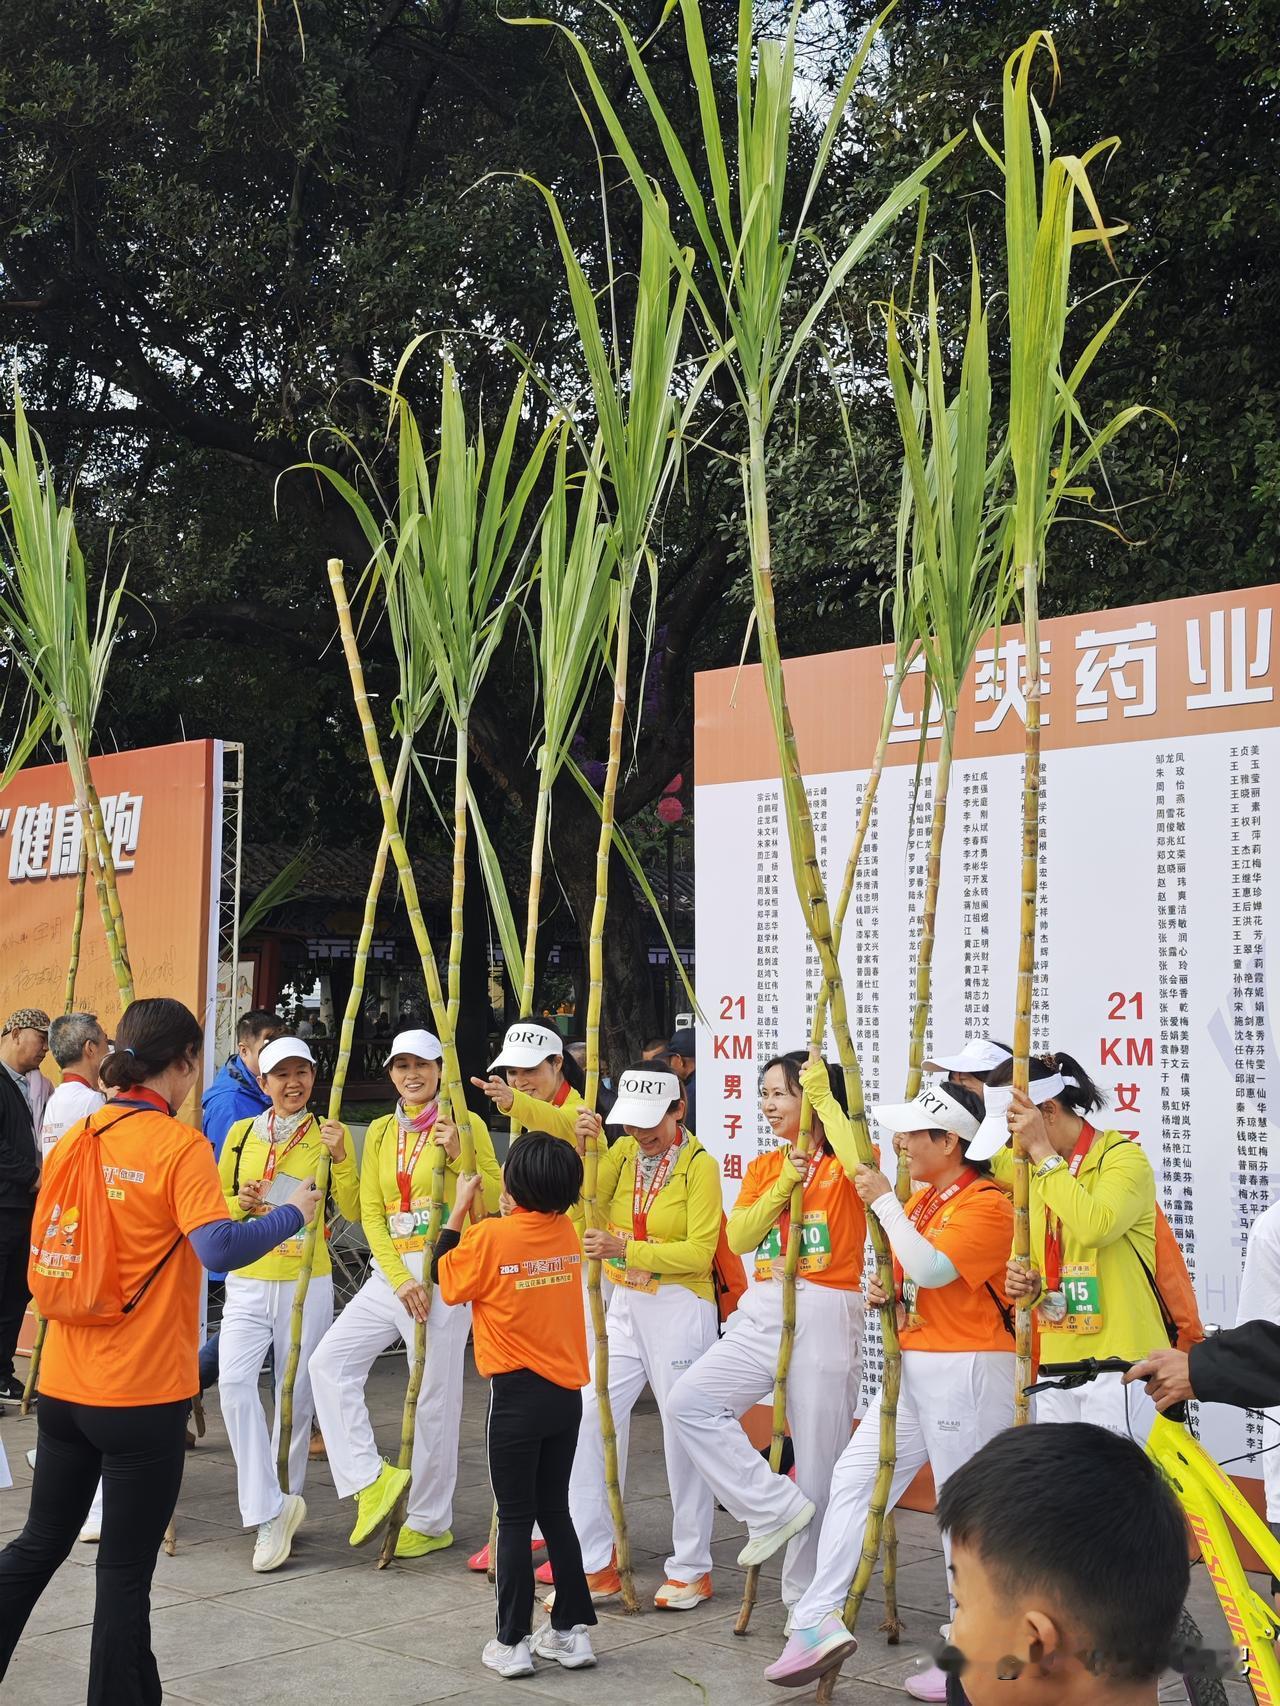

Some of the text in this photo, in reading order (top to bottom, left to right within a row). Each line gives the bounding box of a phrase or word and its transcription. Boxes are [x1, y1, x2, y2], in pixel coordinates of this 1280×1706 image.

[720, 995, 746, 1020] 21
[1108, 992, 1143, 1020] 21
[714, 1035, 752, 1060] KM
[1100, 1038, 1153, 1066] KM
[500, 1265, 519, 1274] 2026
